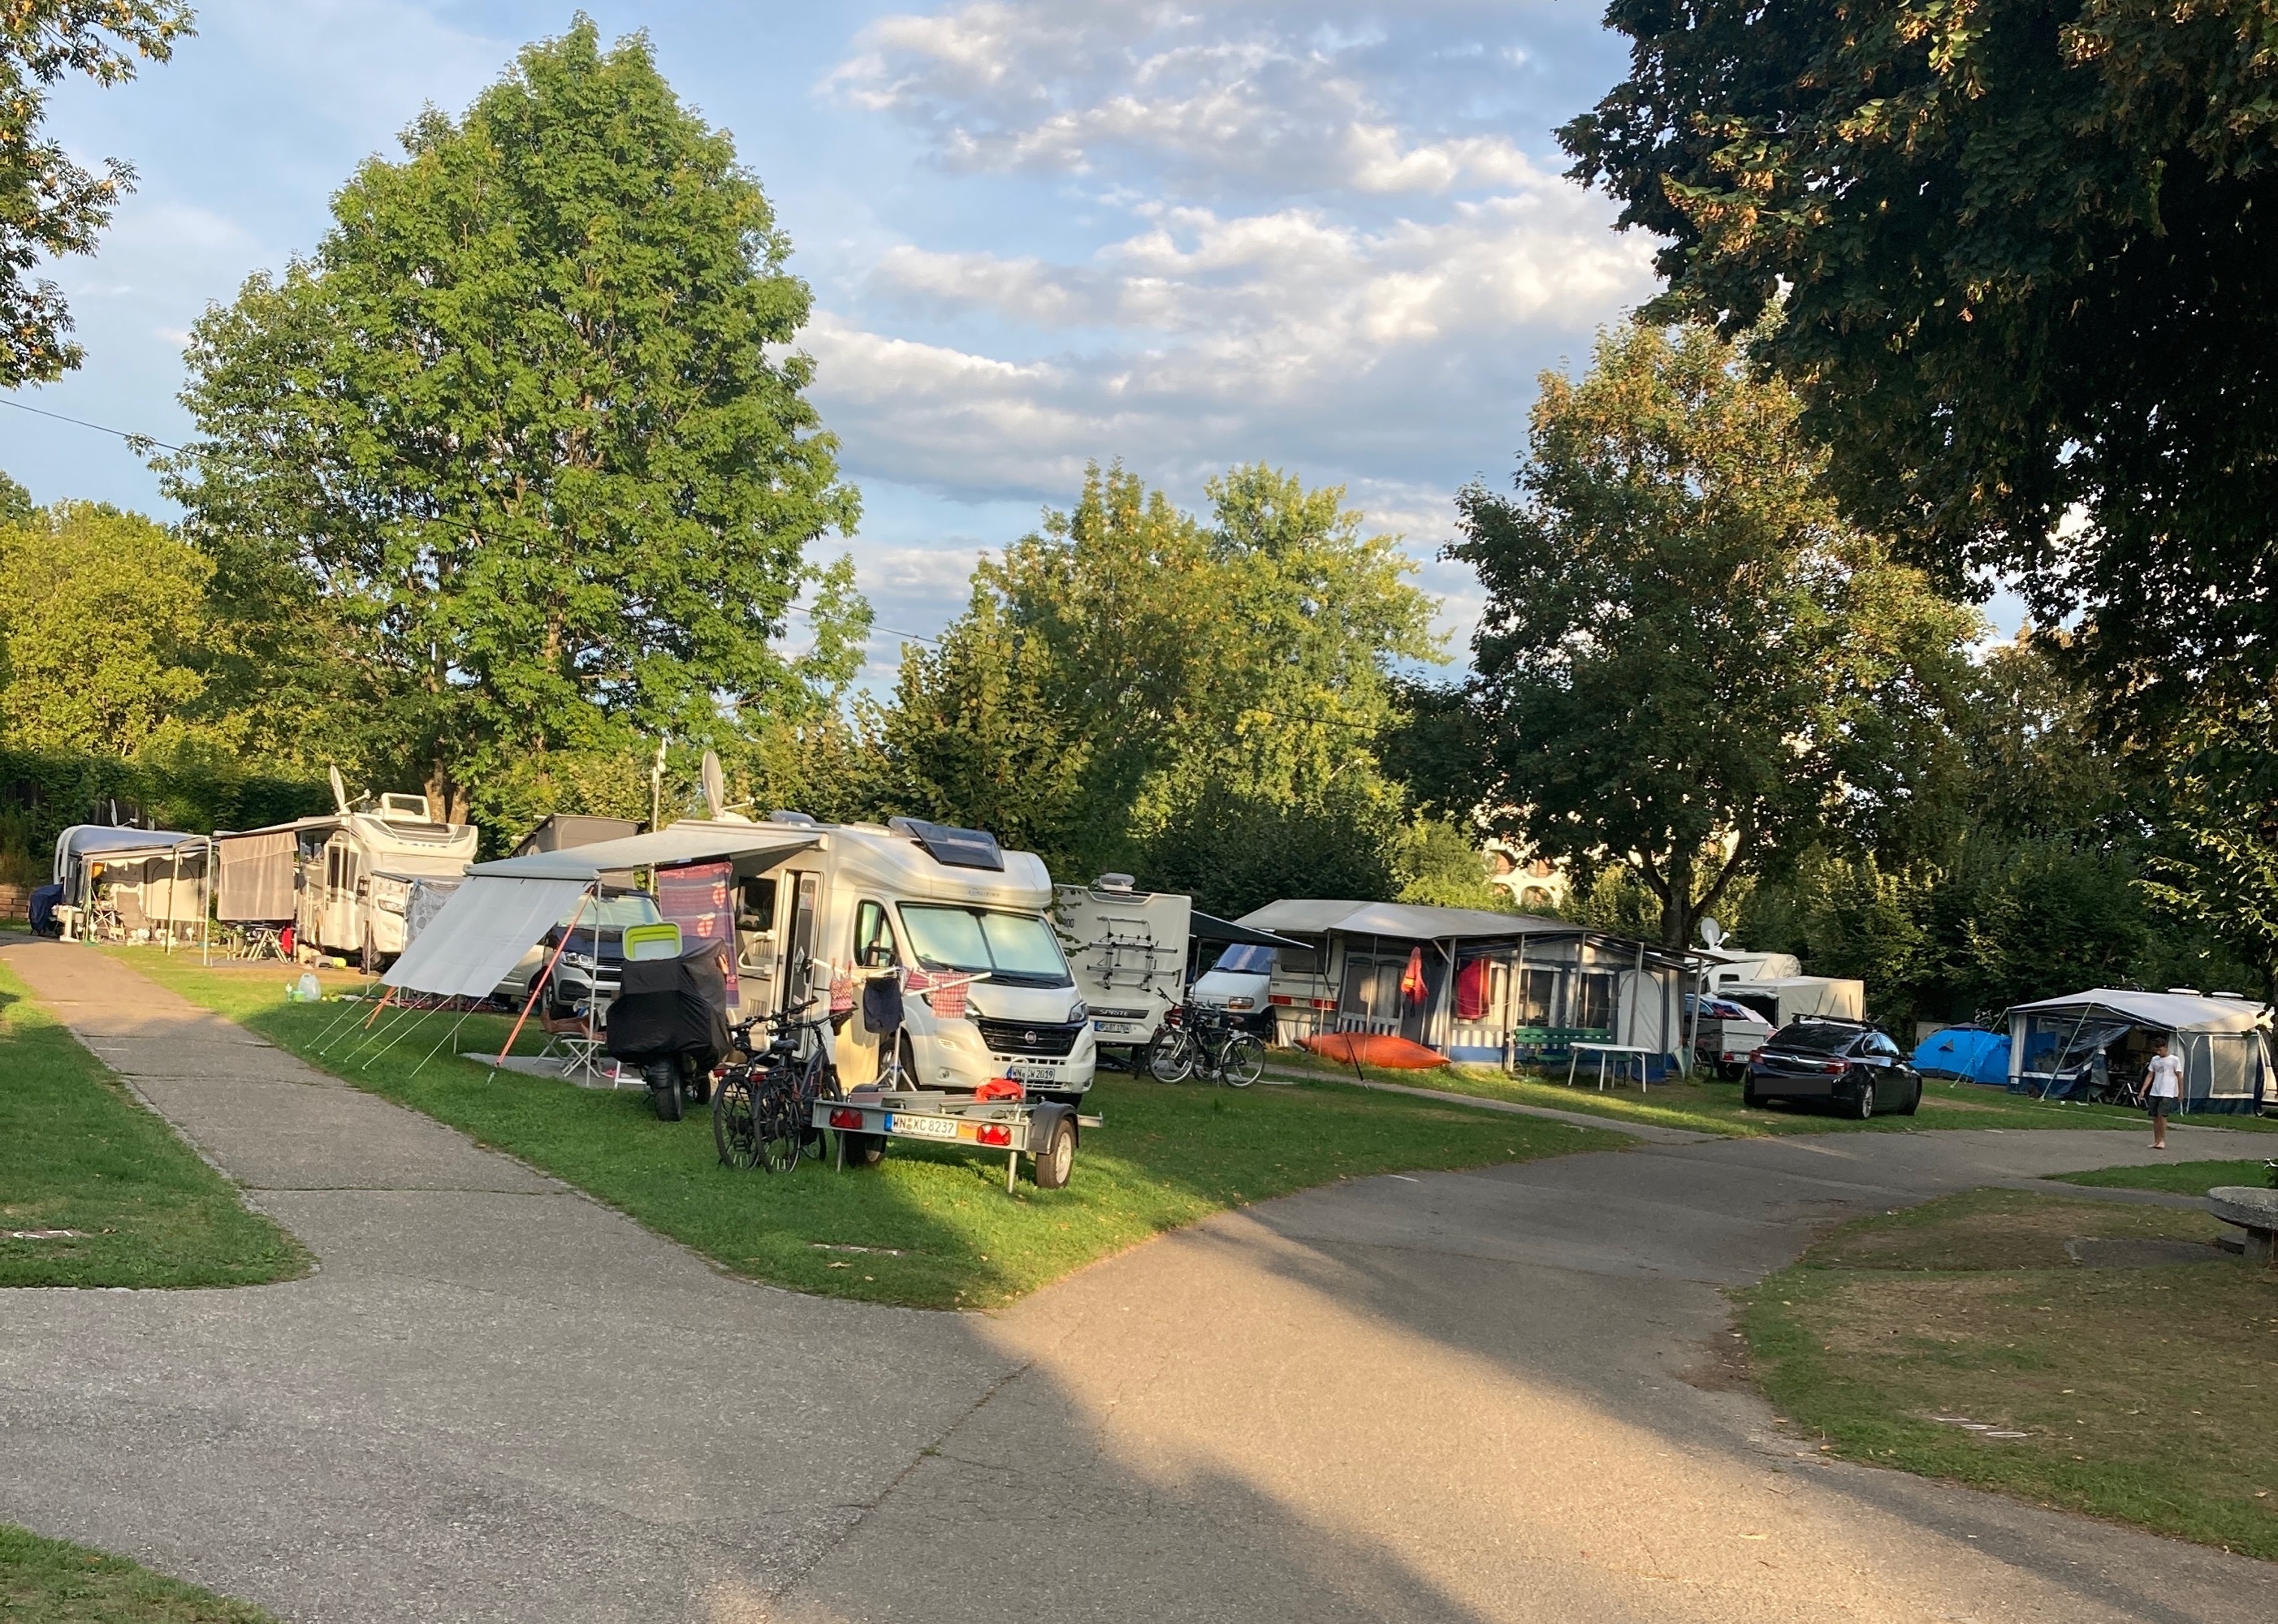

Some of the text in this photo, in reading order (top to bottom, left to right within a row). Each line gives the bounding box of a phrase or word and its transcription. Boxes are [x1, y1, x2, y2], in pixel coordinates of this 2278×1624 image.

[1013, 1067, 1022, 1078] WN
[1035, 1069, 1053, 1079] 2019
[893, 1116, 906, 1129] WN
[913, 1119, 926, 1131] XC
[928, 1121, 954, 1134] 8237
